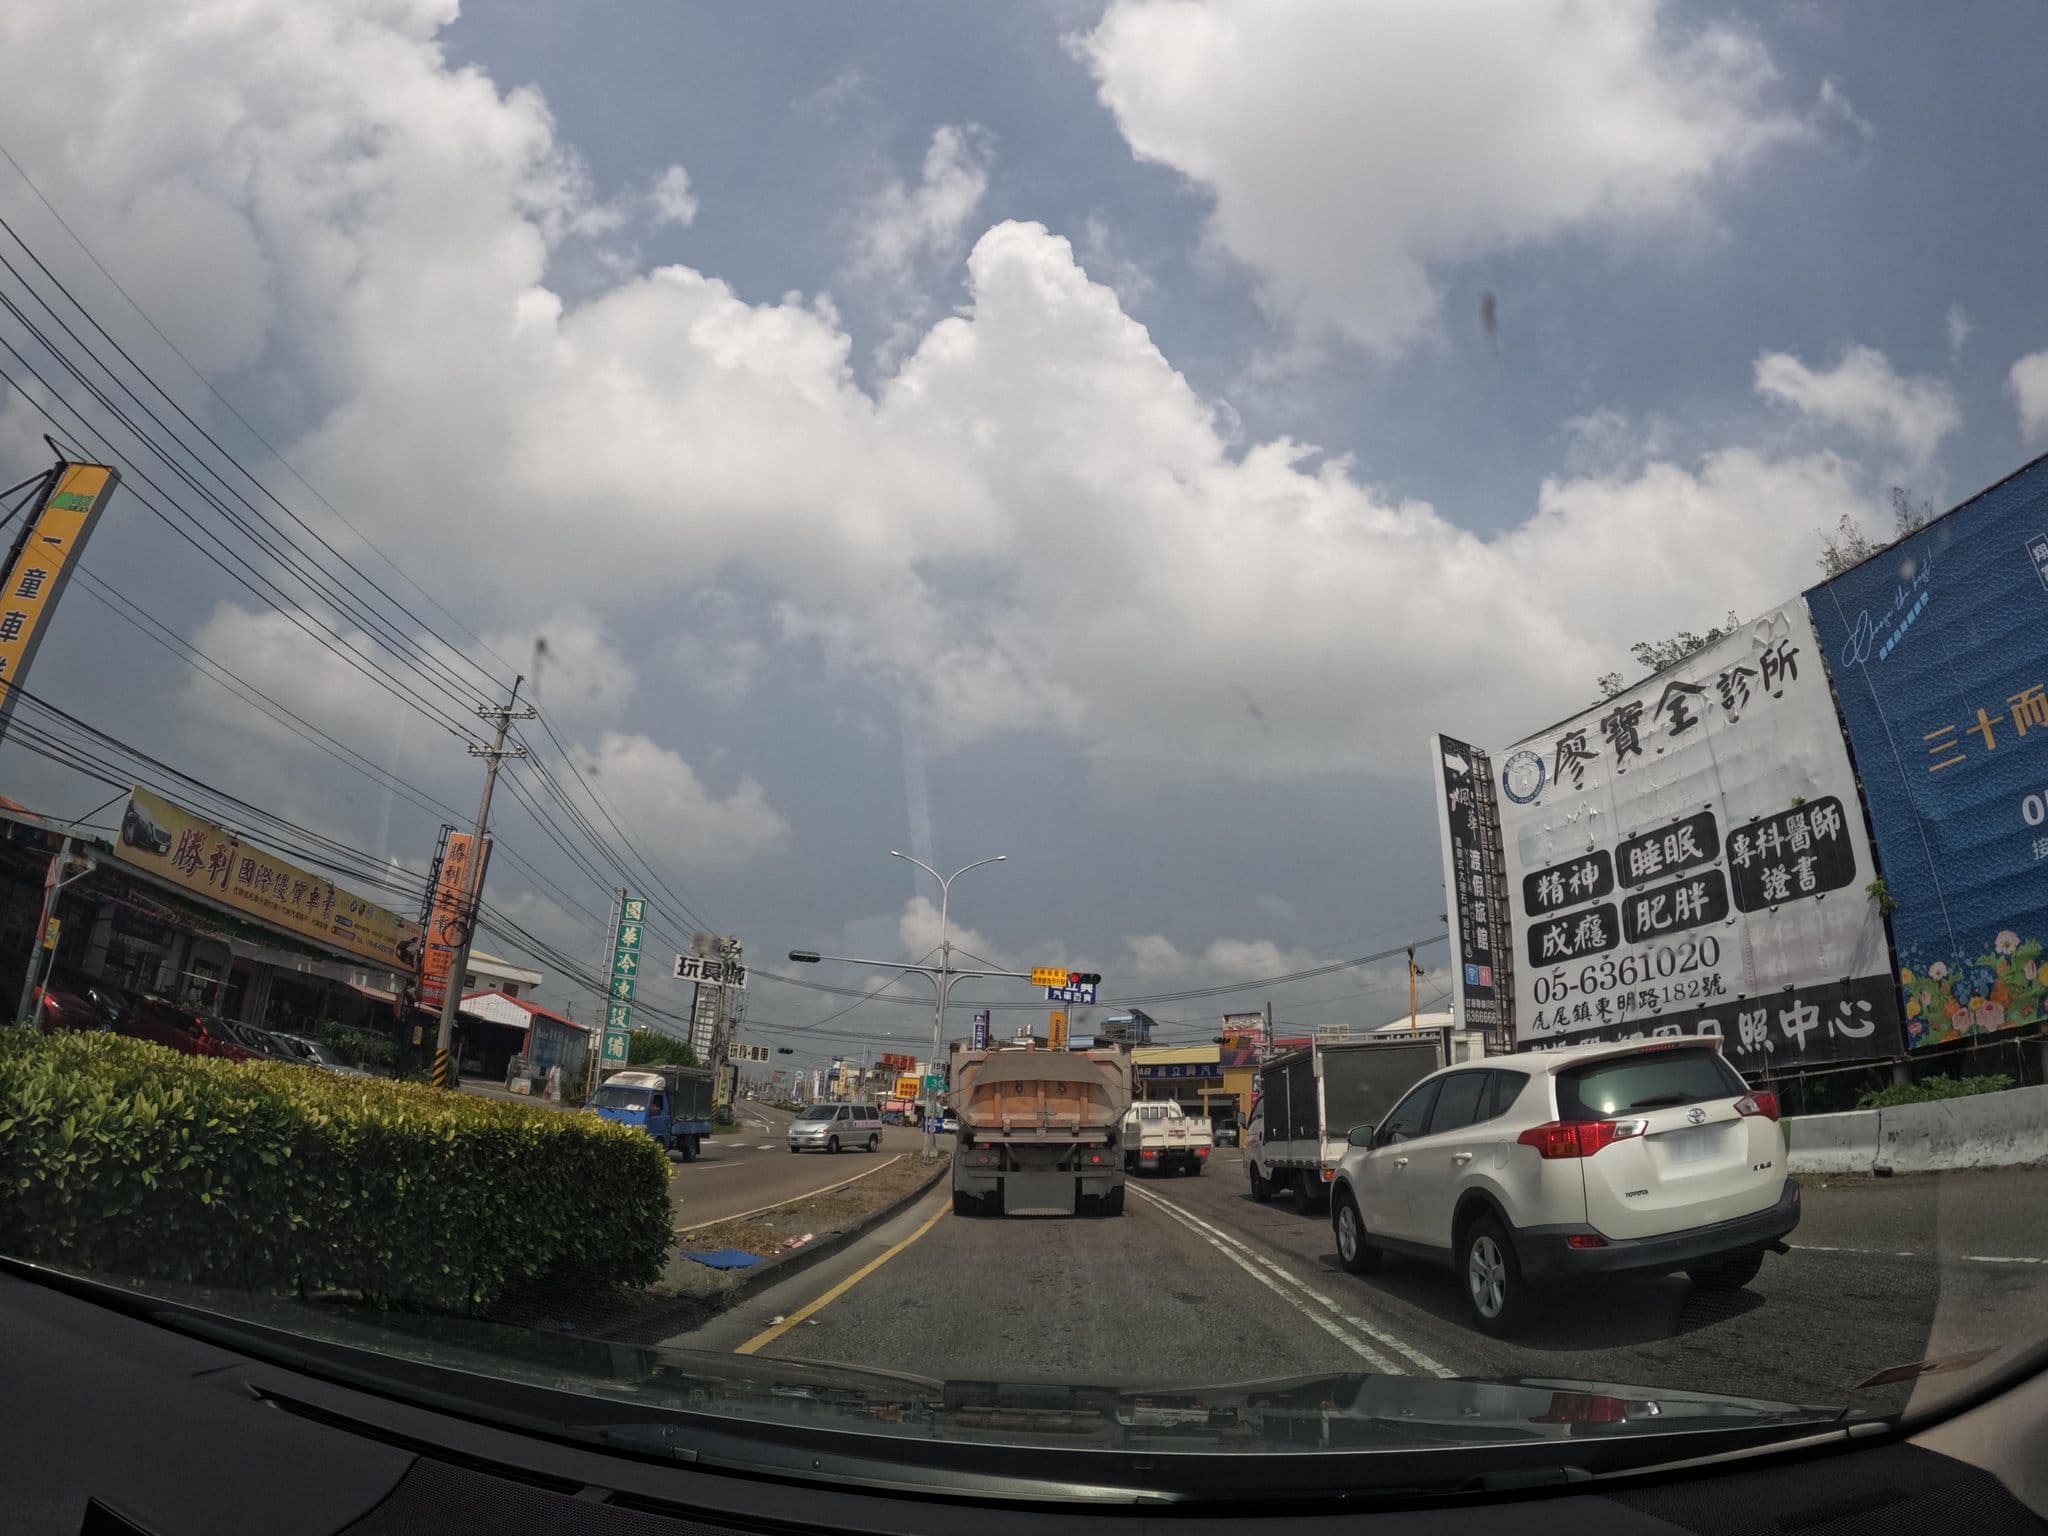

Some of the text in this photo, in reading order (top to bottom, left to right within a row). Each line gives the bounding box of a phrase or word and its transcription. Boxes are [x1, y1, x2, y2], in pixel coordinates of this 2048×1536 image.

[1554, 639, 1800, 786] 廖寶全診所
[171, 827, 239, 892] 勝利
[1629, 824, 1703, 878] 睡眠
[1731, 803, 1841, 869] 專科醫師
[1469, 848, 1489, 951] 渡假旅館
[1537, 868, 1600, 908] 精神
[1635, 877, 1710, 935] 肥胖
[1760, 855, 1818, 901] 證書
[1541, 914, 1608, 960] 成癮
[1050, 980, 1093, 994] 立興
[1533, 935, 1721, 1005] 05-6361020
[1531, 972, 1727, 1032] 虎尾鎮東明路182號
[1624, 1188, 1649, 1198] TOYOTA
